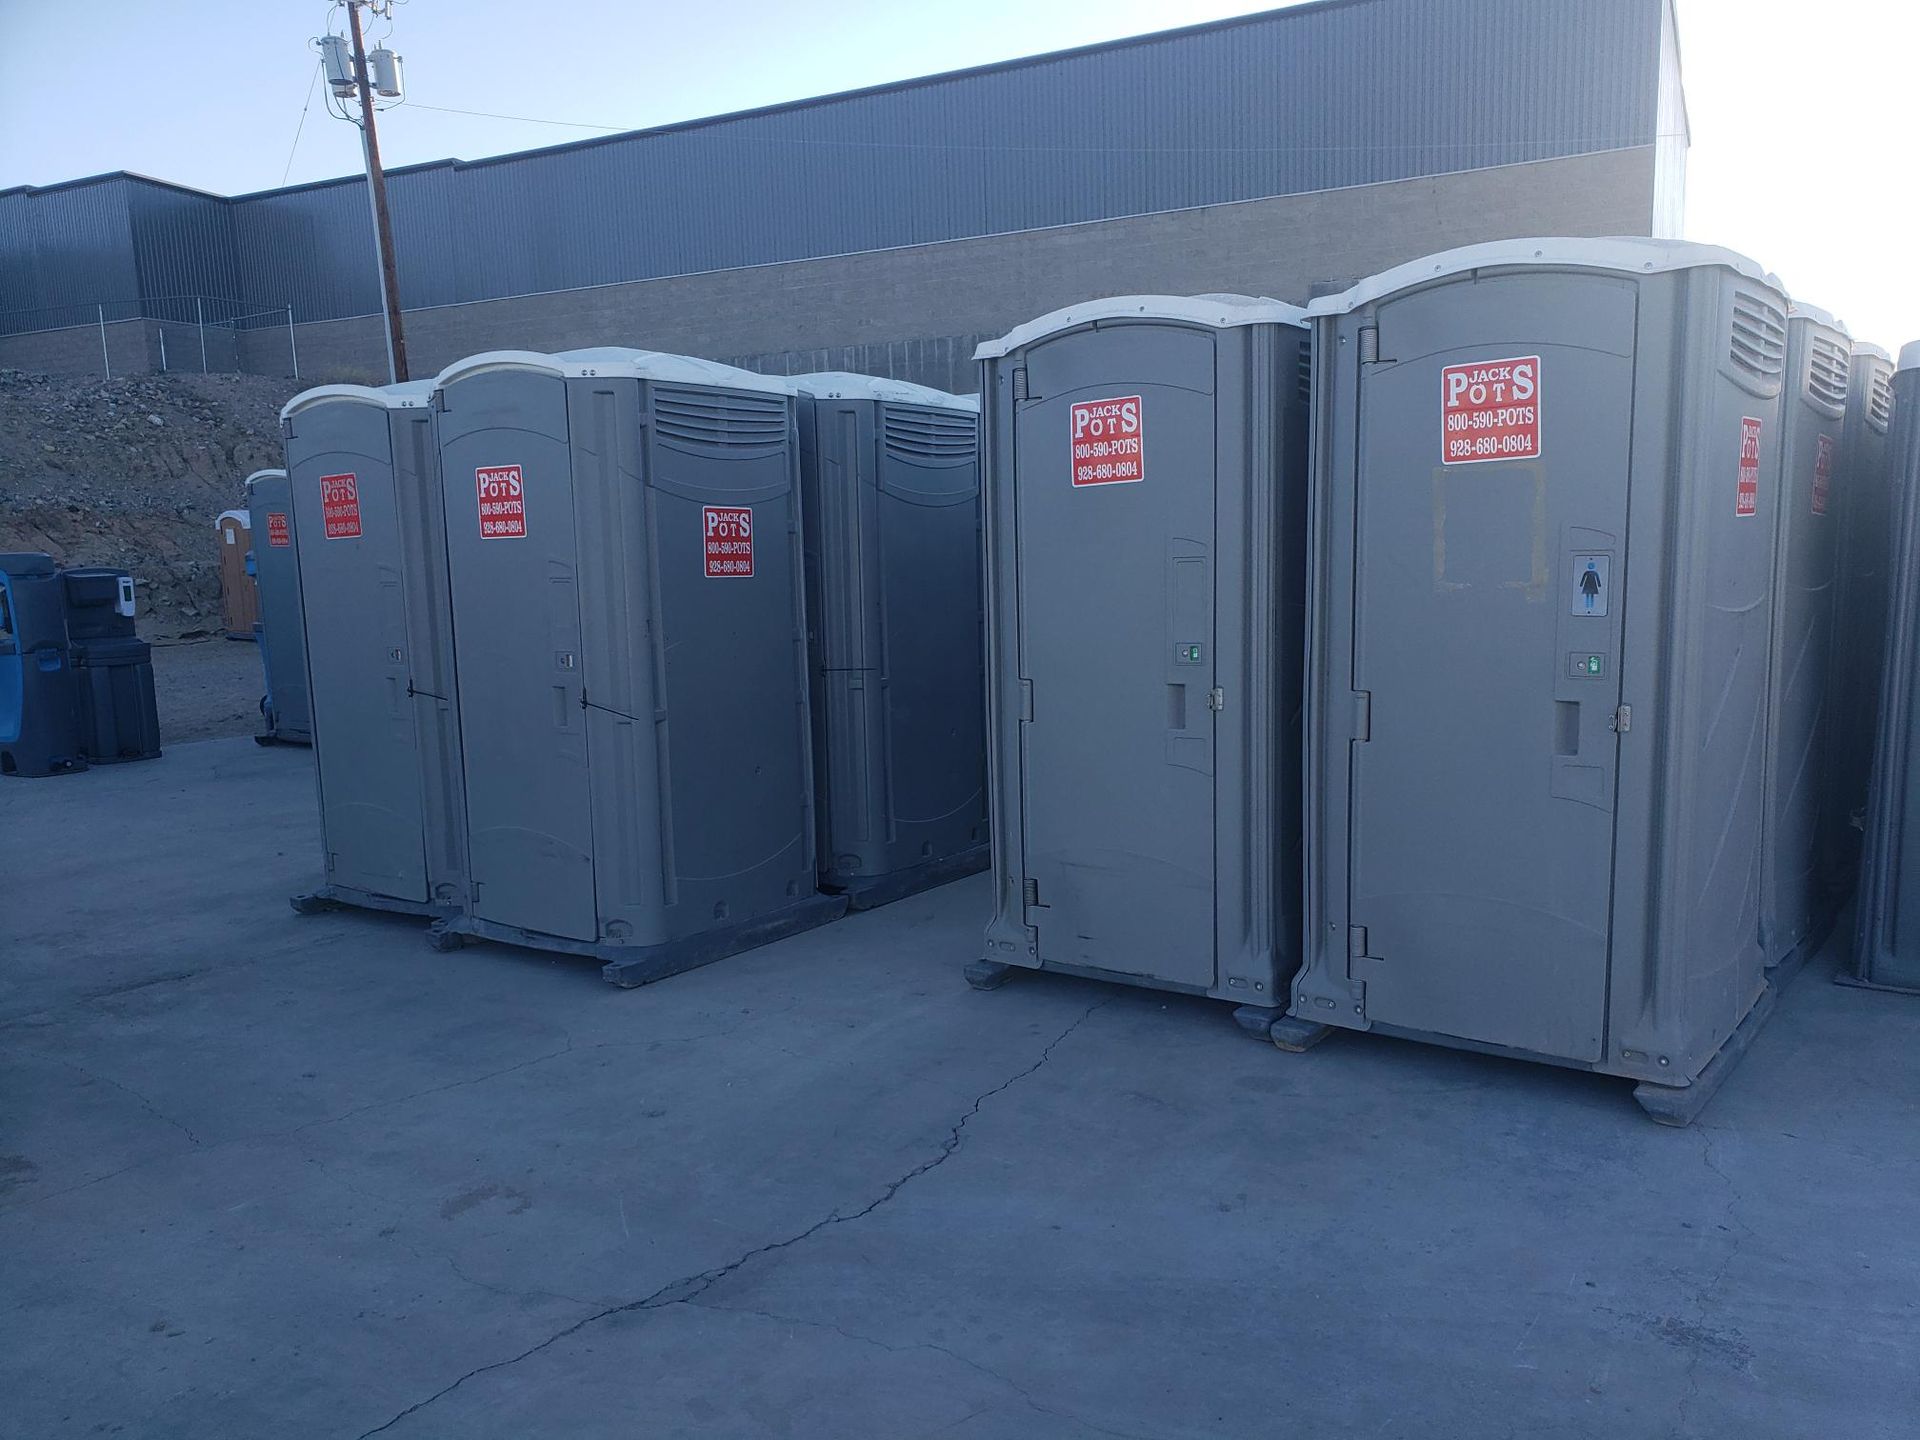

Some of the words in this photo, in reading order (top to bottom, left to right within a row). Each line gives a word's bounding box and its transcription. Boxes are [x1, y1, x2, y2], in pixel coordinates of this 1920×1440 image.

[1447, 364, 1534, 407] POTS
[1469, 367, 1511, 383] JACK
[1074, 402, 1138, 438] POTS
[1090, 404, 1120, 418] JACK
[1447, 406, 1534, 431] 800-590-POTS
[1075, 438, 1138, 459] 800-590-POTS
[1450, 434, 1532, 457] 928-680-0804
[489, 472, 508, 481] JACK
[1077, 460, 1137, 480] 928-680-0804
[322, 478, 356, 503] POTS
[479, 470, 520, 497] POTS
[706, 512, 750, 537] POTS
[718, 512, 739, 522] JACK
